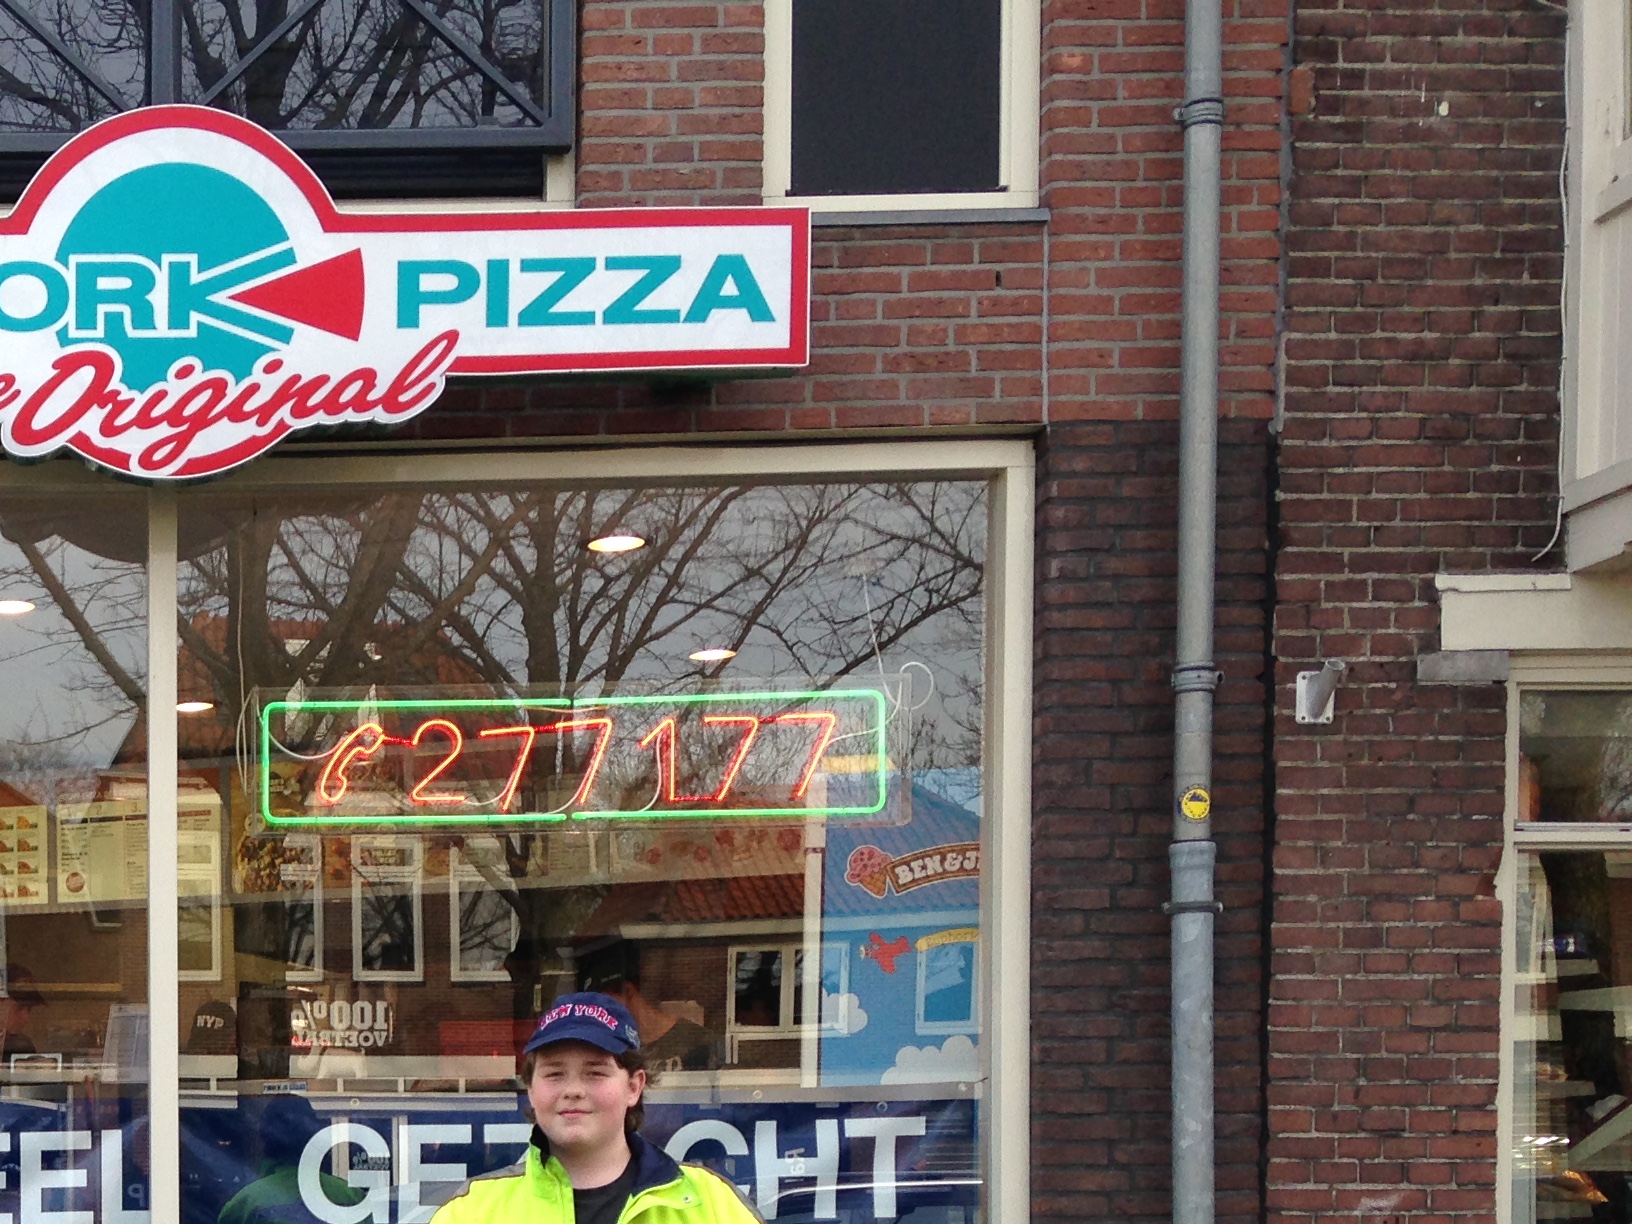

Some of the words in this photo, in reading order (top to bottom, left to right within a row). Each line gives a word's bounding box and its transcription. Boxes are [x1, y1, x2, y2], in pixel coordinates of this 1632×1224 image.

[397, 253, 776, 330] PIZZA
[18, 330, 460, 464] Original
[410, 711, 838, 813] 277177
[540, 1004, 573, 1031] NEW
[574, 1004, 619, 1031] YORK
